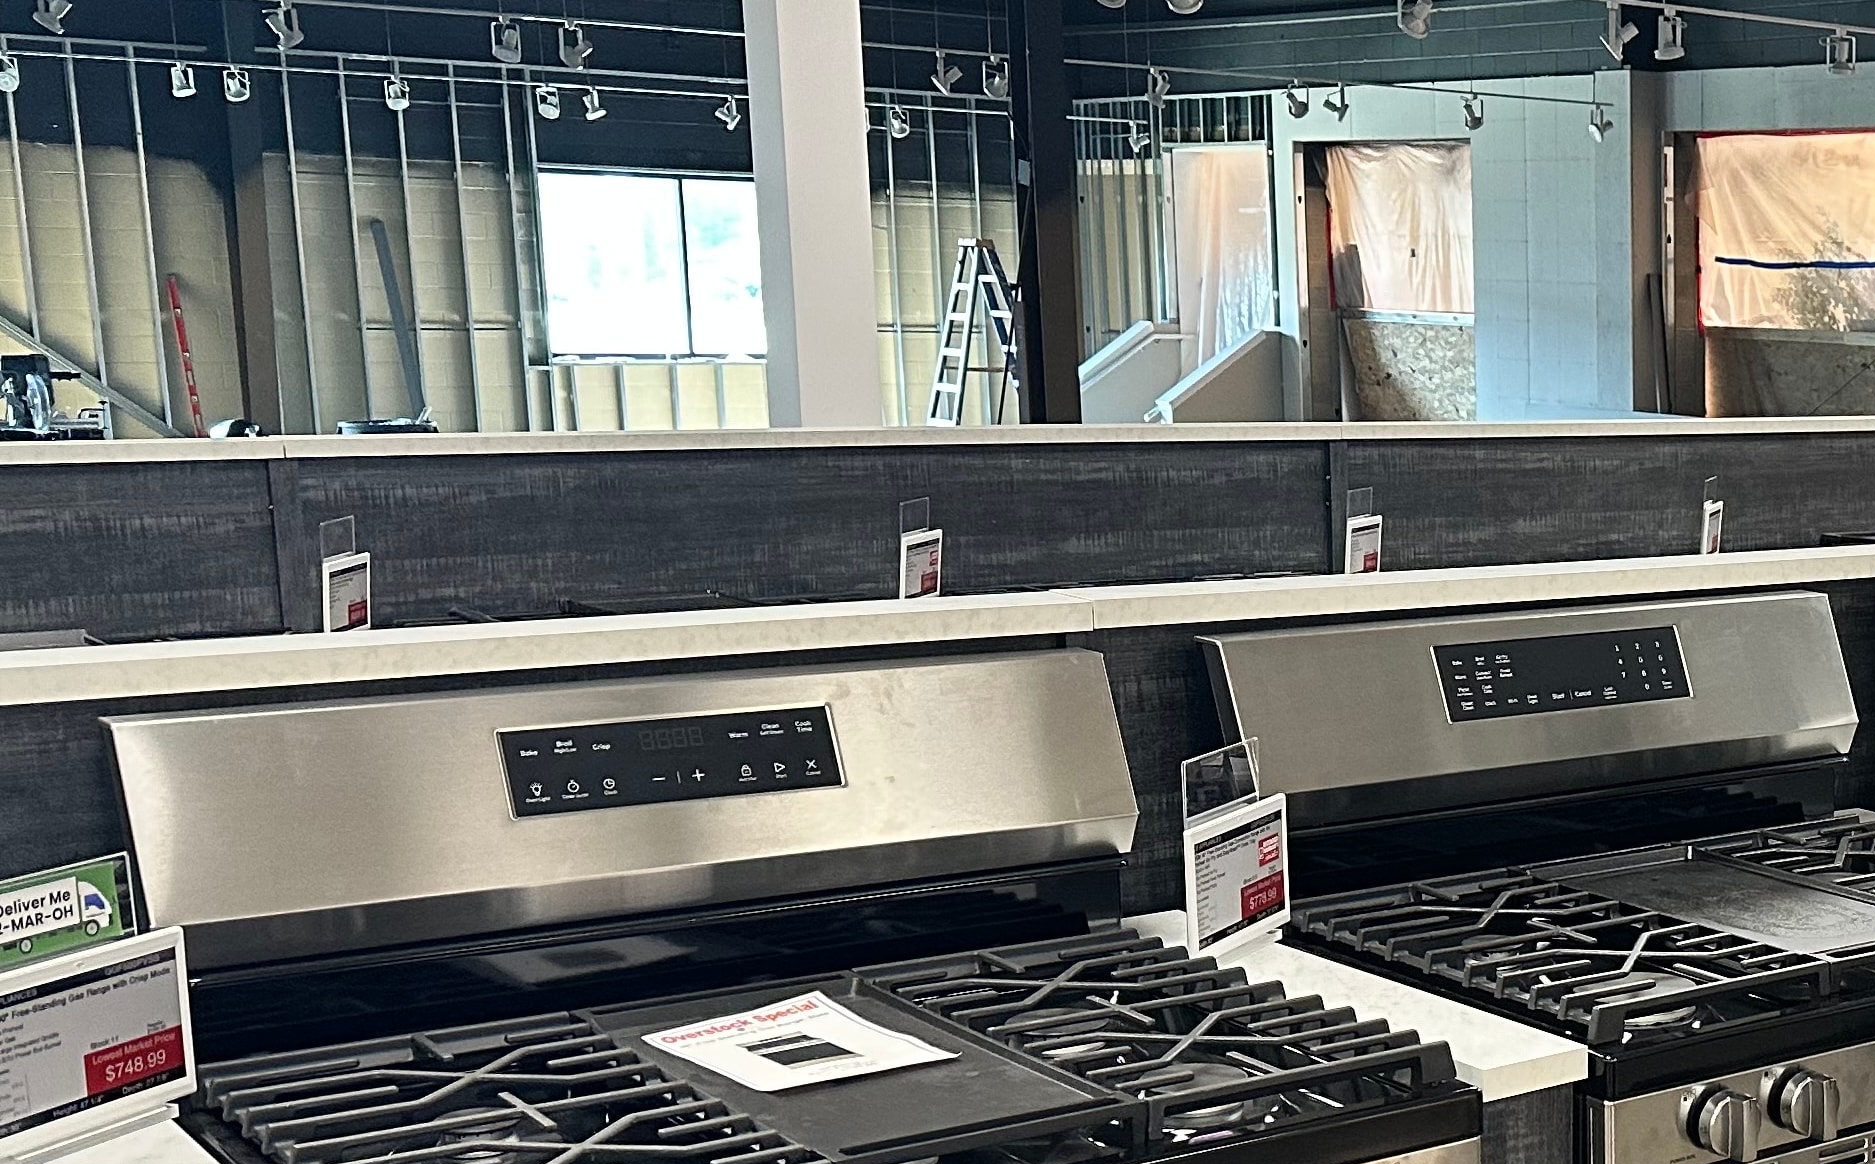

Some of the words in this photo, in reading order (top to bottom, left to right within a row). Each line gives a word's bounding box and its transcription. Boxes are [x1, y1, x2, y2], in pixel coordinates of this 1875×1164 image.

[49, 890, 71, 906] Me
[660, 1018, 753, 1044] Overstock
[752, 1000, 820, 1021] Special
[92, 1047, 123, 1066] Lowest
[123, 1039, 154, 1055] Market
[154, 1032, 176, 1045] Price
[105, 1049, 166, 1082] $748.99
